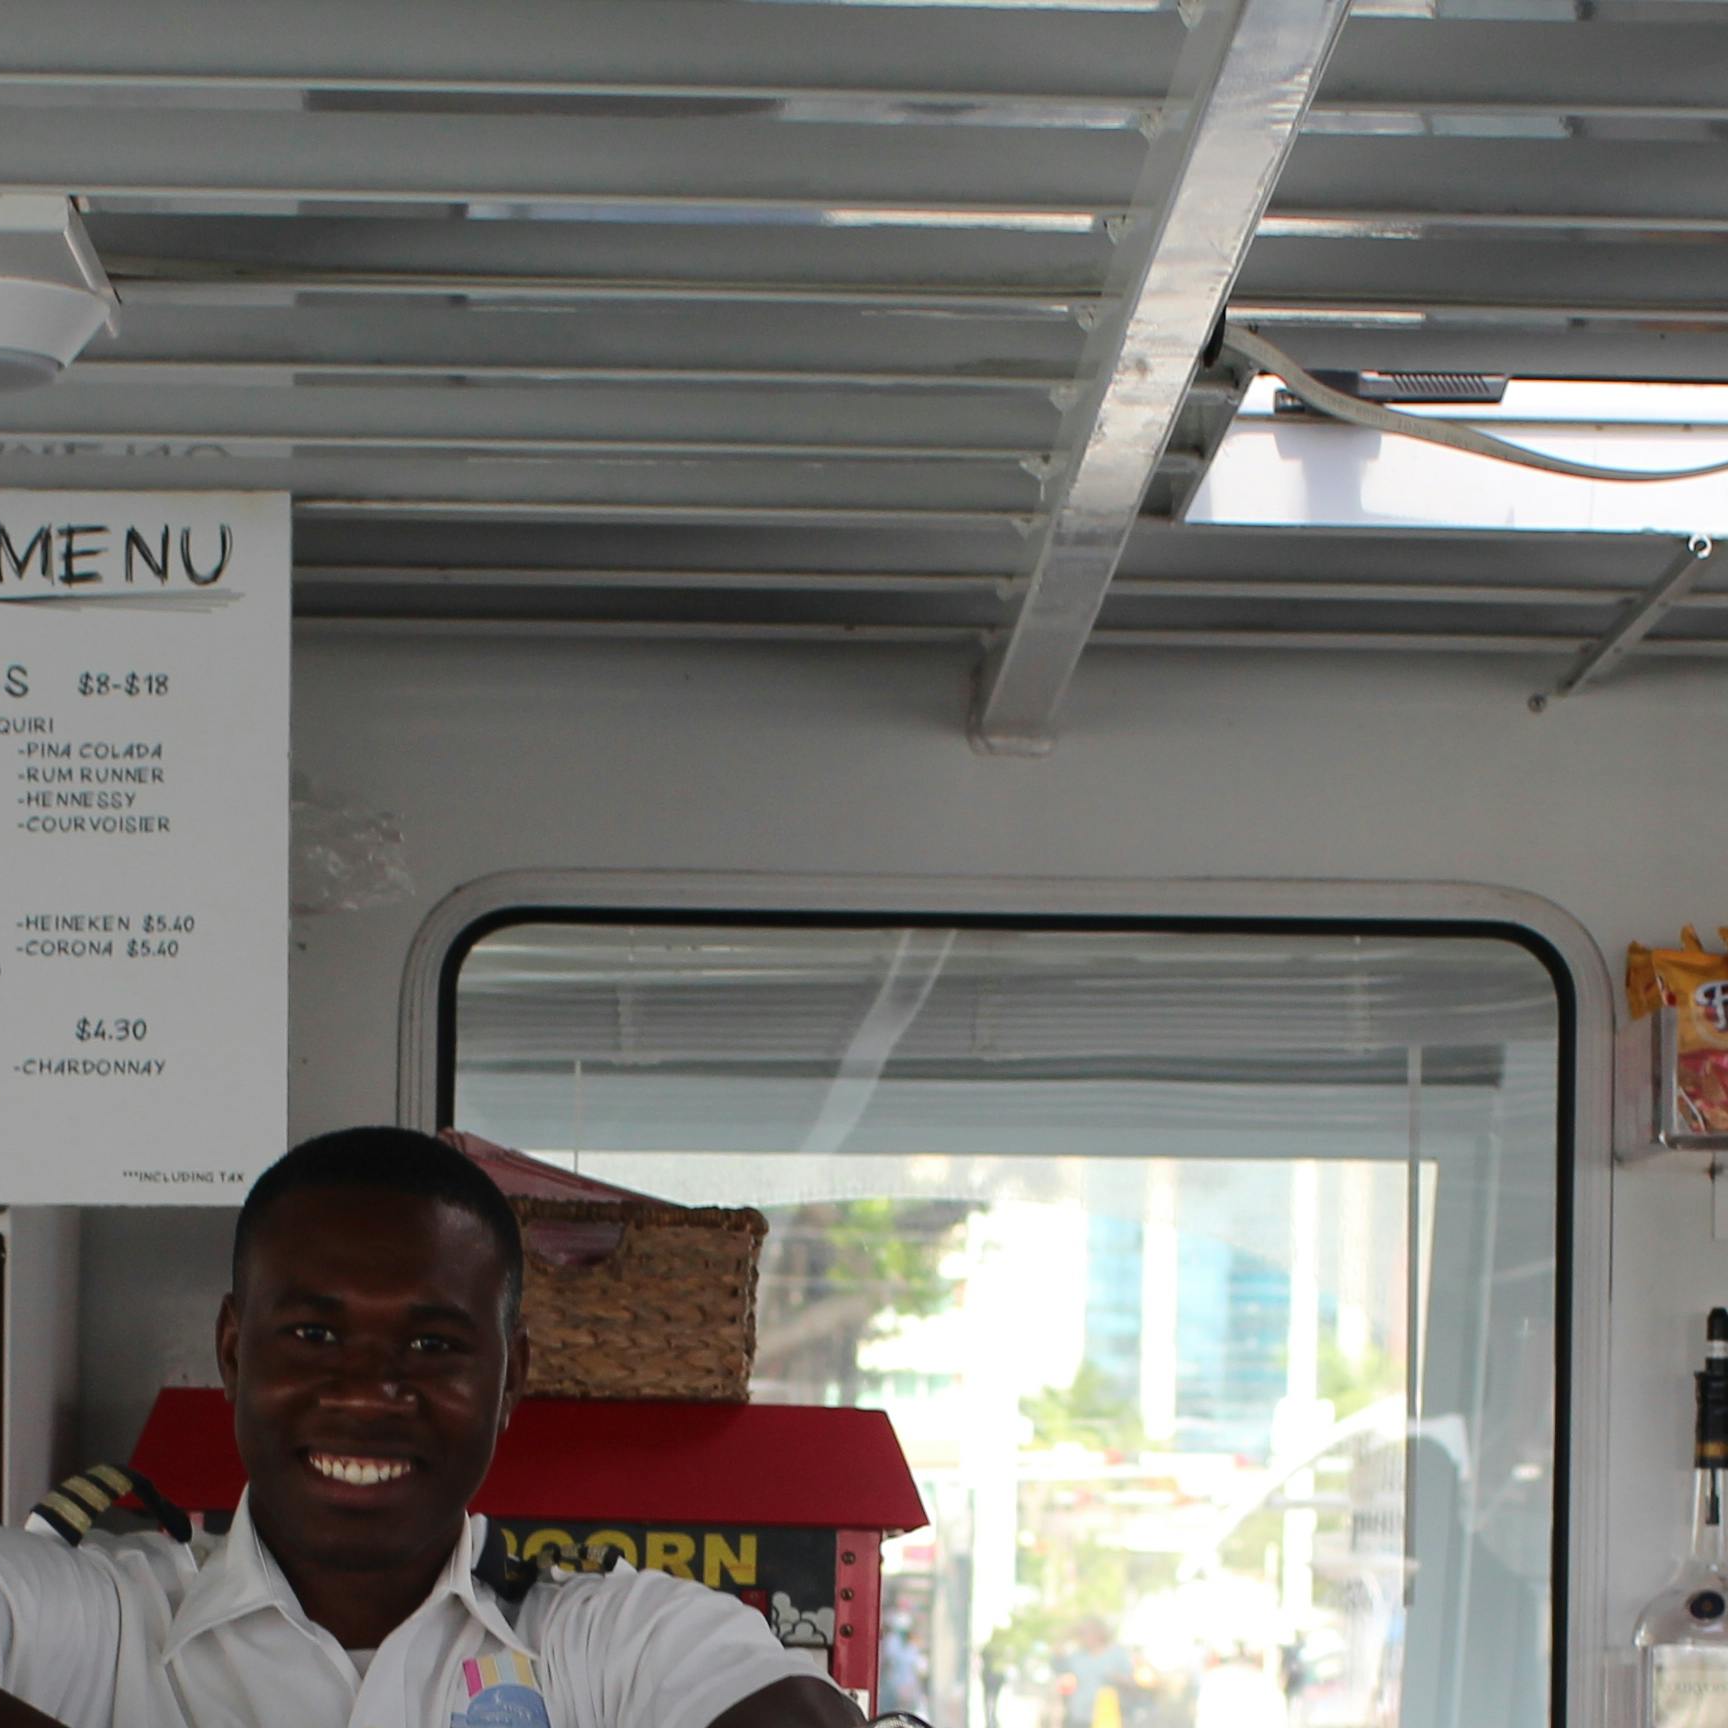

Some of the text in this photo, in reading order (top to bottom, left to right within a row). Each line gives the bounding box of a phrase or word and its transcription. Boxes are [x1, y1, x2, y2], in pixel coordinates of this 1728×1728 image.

[77, 670, 170, 699] $8-$18
[78, 741, 163, 761] COLADA
[79, 765, 165, 785] RUNNER
[141, 912, 196, 935] $5.40
[125, 937, 180, 959] $5.40
[74, 1016, 148, 1044] $4.30
[218, 1170, 245, 1184] TAX
